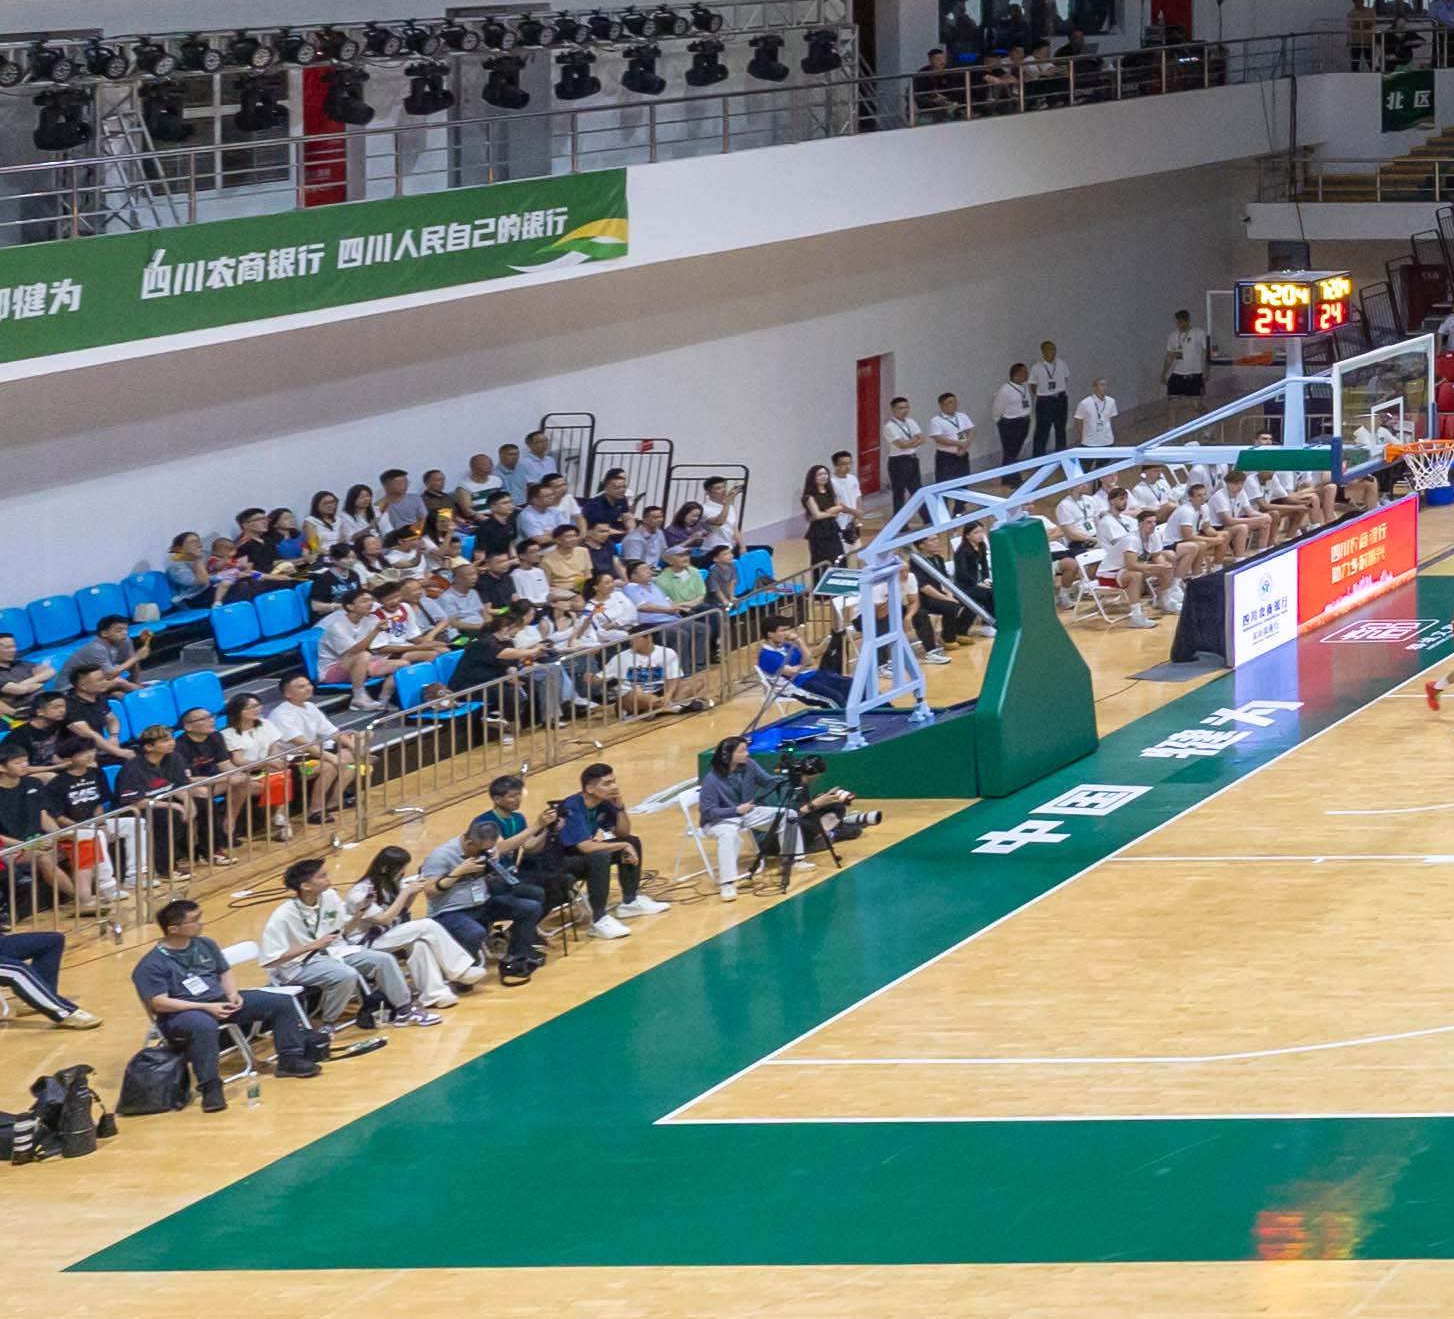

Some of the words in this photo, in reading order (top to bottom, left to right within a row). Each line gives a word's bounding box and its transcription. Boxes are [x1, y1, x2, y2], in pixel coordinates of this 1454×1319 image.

[1386, 90, 1431, 110] 北区
[140, 242, 325, 300] 四川农商银行
[338, 207, 569, 270] 四川人民自己的银行
[1254, 307, 1295, 334] 24
[1319, 302, 1342, 329] 24
[1138, 700, 1305, 759] 犍为
[970, 784, 1154, 855] 中国
